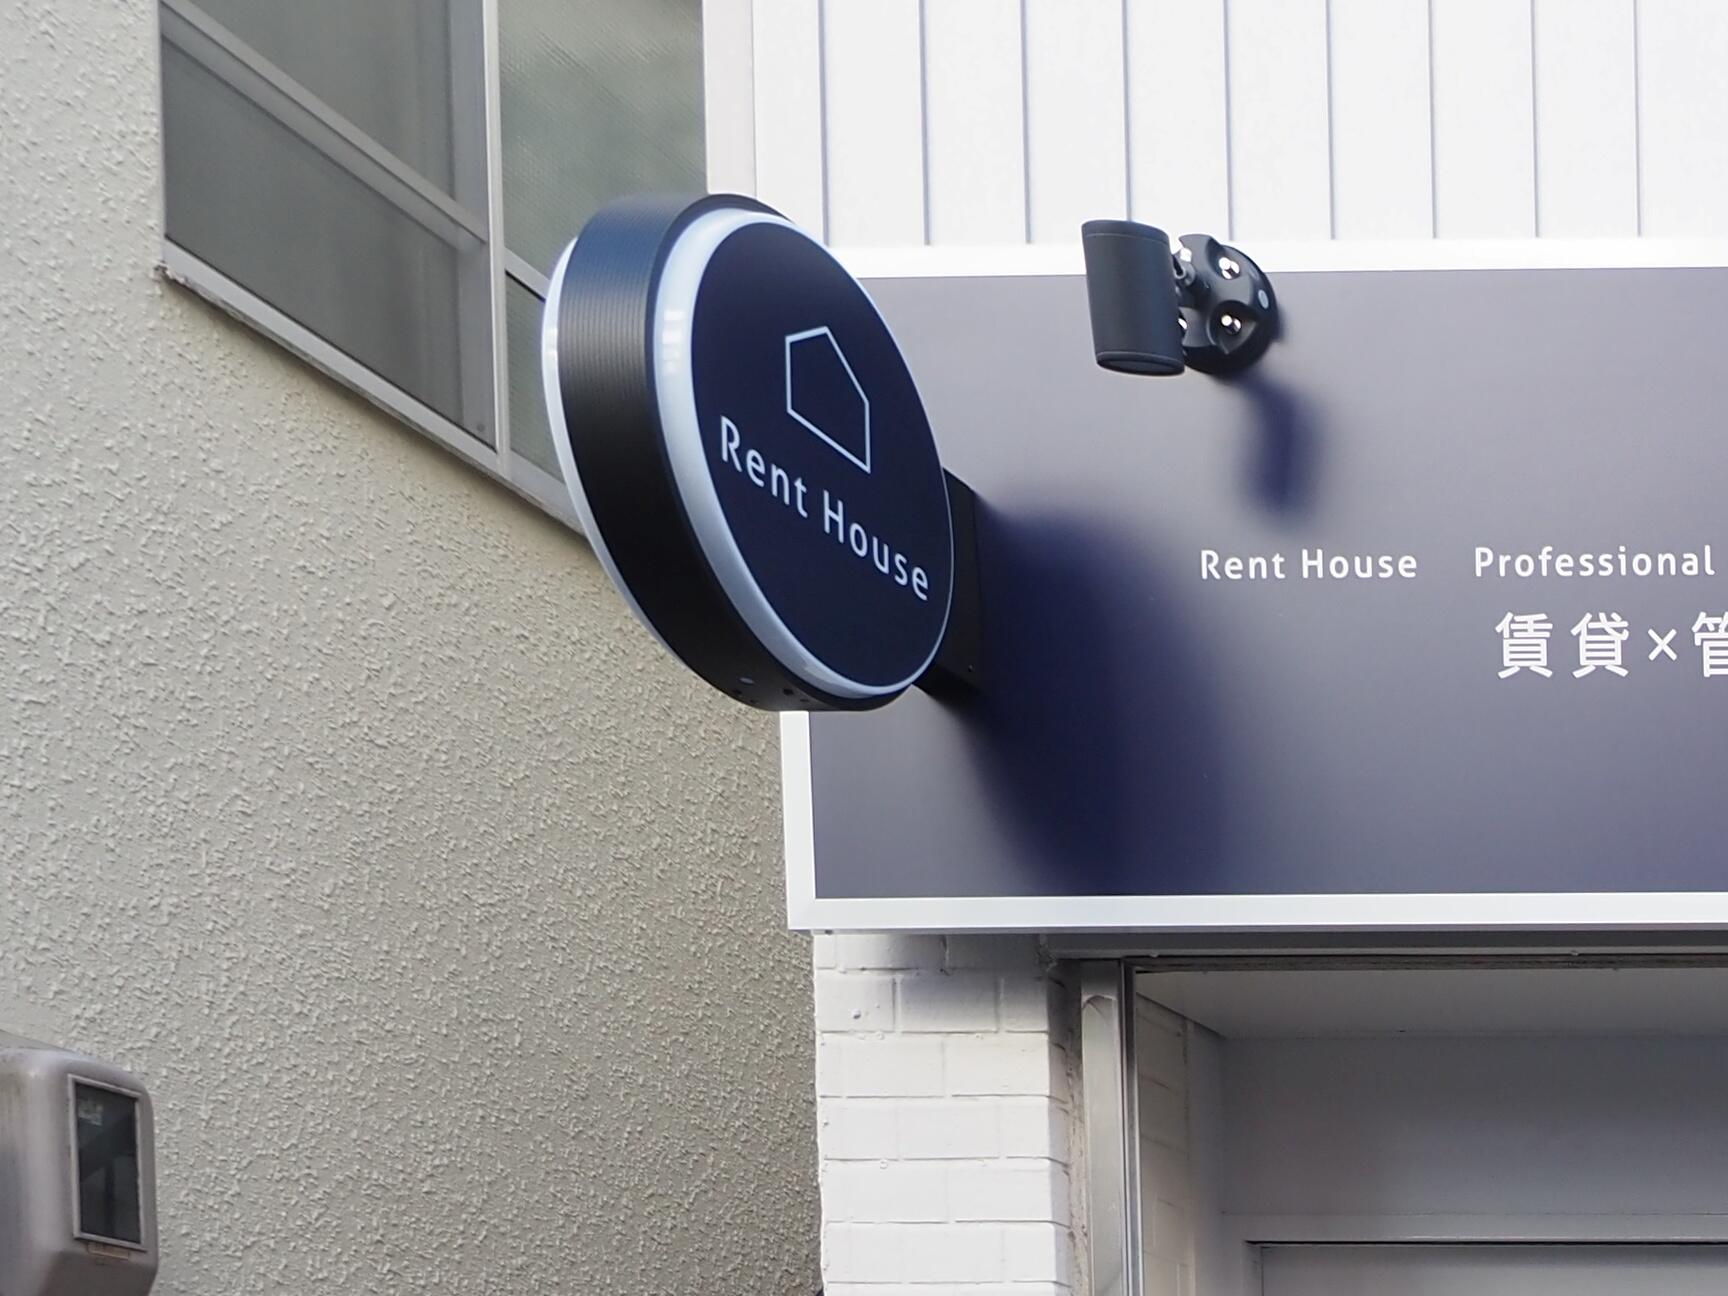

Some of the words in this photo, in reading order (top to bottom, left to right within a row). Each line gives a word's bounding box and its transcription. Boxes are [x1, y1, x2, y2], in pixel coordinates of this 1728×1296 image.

[719, 413, 809, 518] Rent
[821, 499, 930, 604] House
[1201, 549, 1286, 580] Rent
[1302, 548, 1417, 579] House
[1475, 544, 1716, 577] Professional
